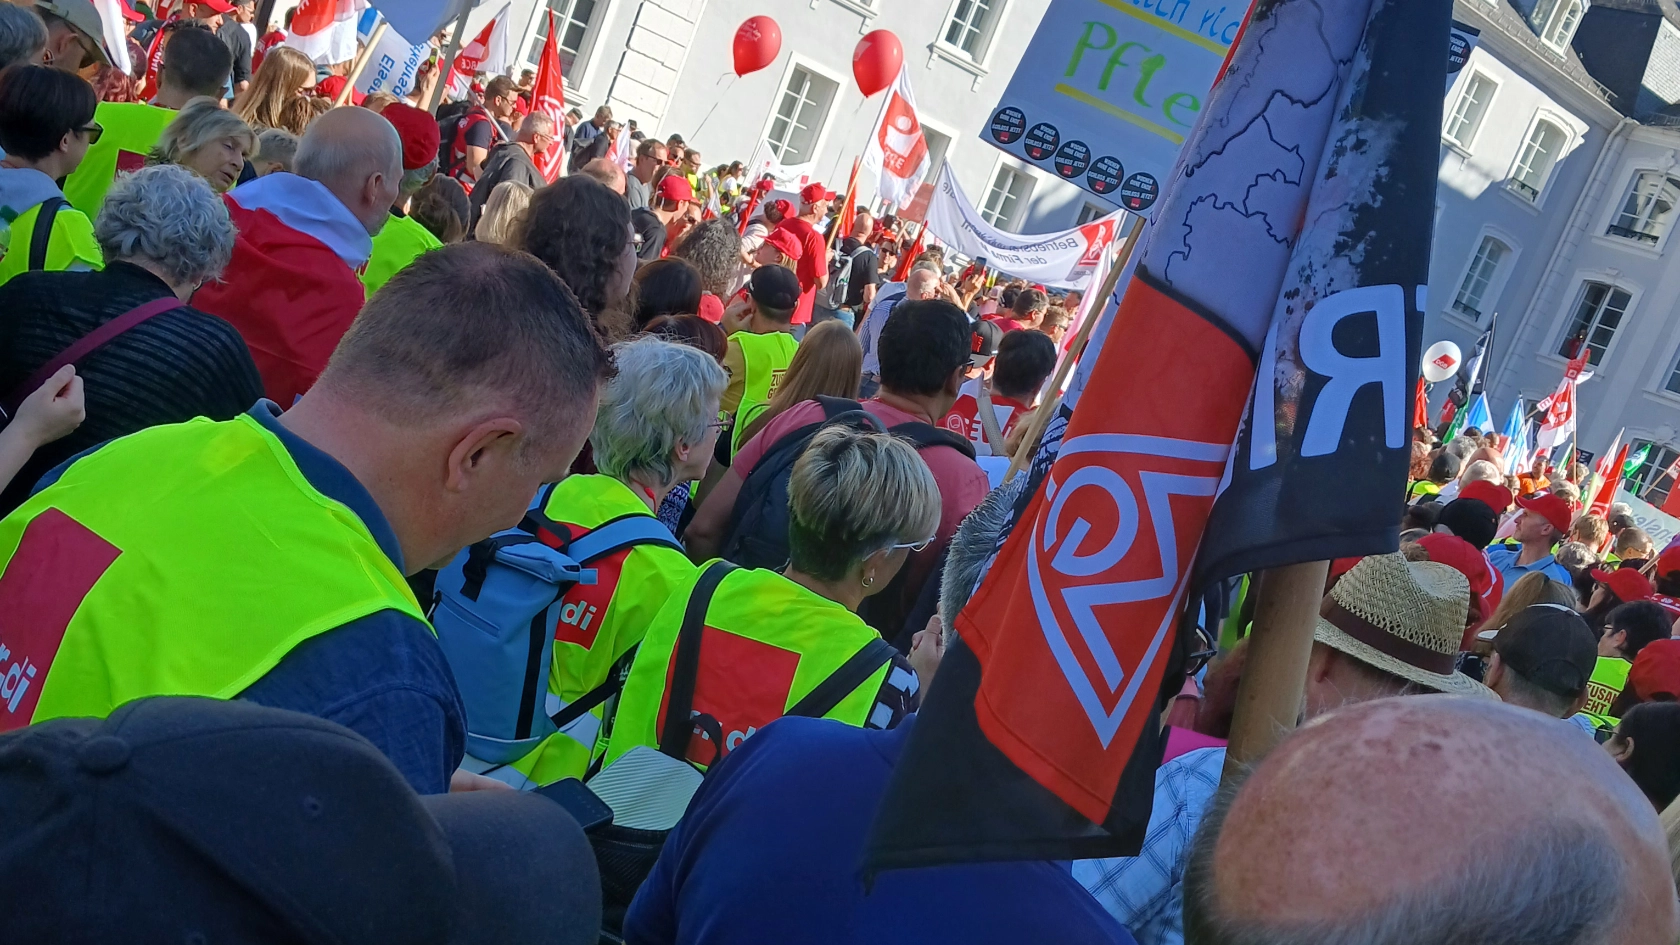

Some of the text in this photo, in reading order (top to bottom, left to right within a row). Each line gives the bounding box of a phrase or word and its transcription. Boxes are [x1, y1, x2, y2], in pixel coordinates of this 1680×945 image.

[1198, 6, 1241, 45] ric
[1063, 21, 1201, 128] Pfle
[1583, 698, 1607, 716] EHT
